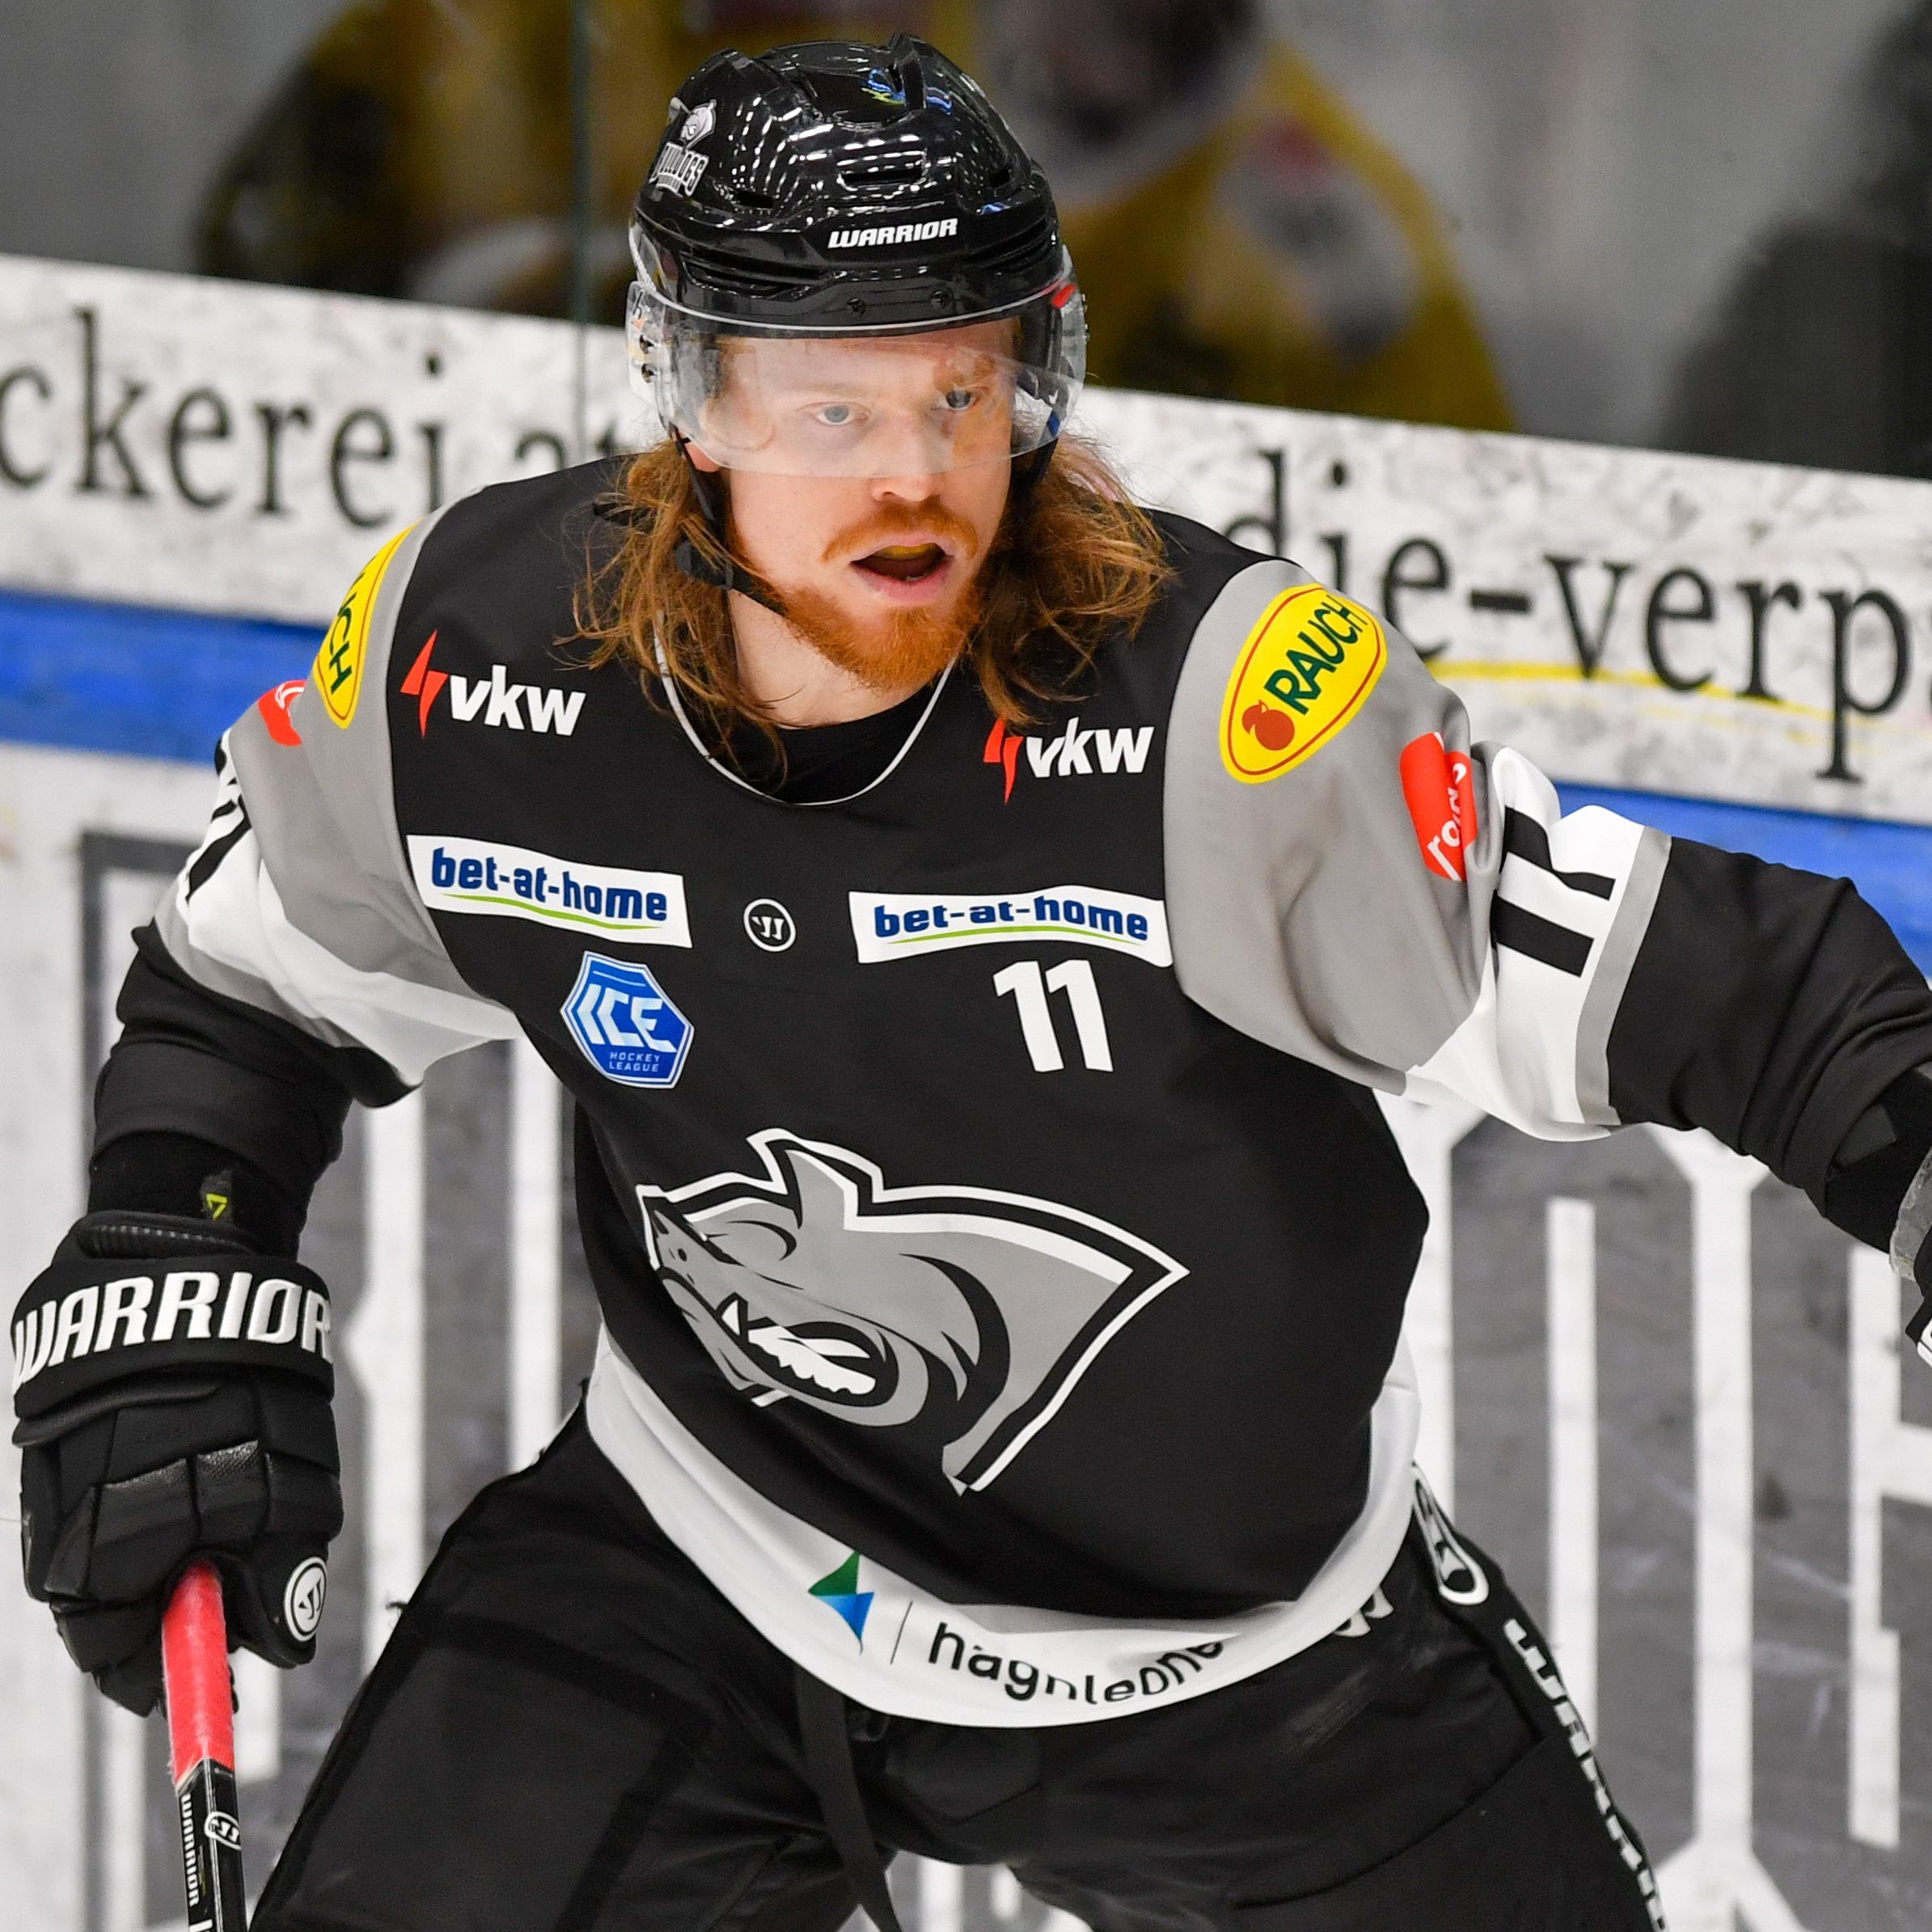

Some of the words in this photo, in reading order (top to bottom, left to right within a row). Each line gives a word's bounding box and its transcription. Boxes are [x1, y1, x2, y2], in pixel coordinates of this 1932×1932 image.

[827, 218, 958, 249] WARRIOR
[1222, 447, 1932, 783] die-verp
[1264, 594, 1368, 715] RAUCH
[450, 664, 586, 737] vkw
[1025, 717, 1155, 778] vkw
[431, 847, 668, 922] bet-at-home
[873, 895, 1148, 941] bet-at-home
[577, 983, 677, 1053] ICE
[992, 959, 1114, 1072] 11
[609, 1061, 659, 1072] LEAGUE
[610, 1051, 660, 1062] HOCKEY
[12, 1271, 333, 1396] WARRIOR
[180, 1793, 200, 1908] WARRIOR
